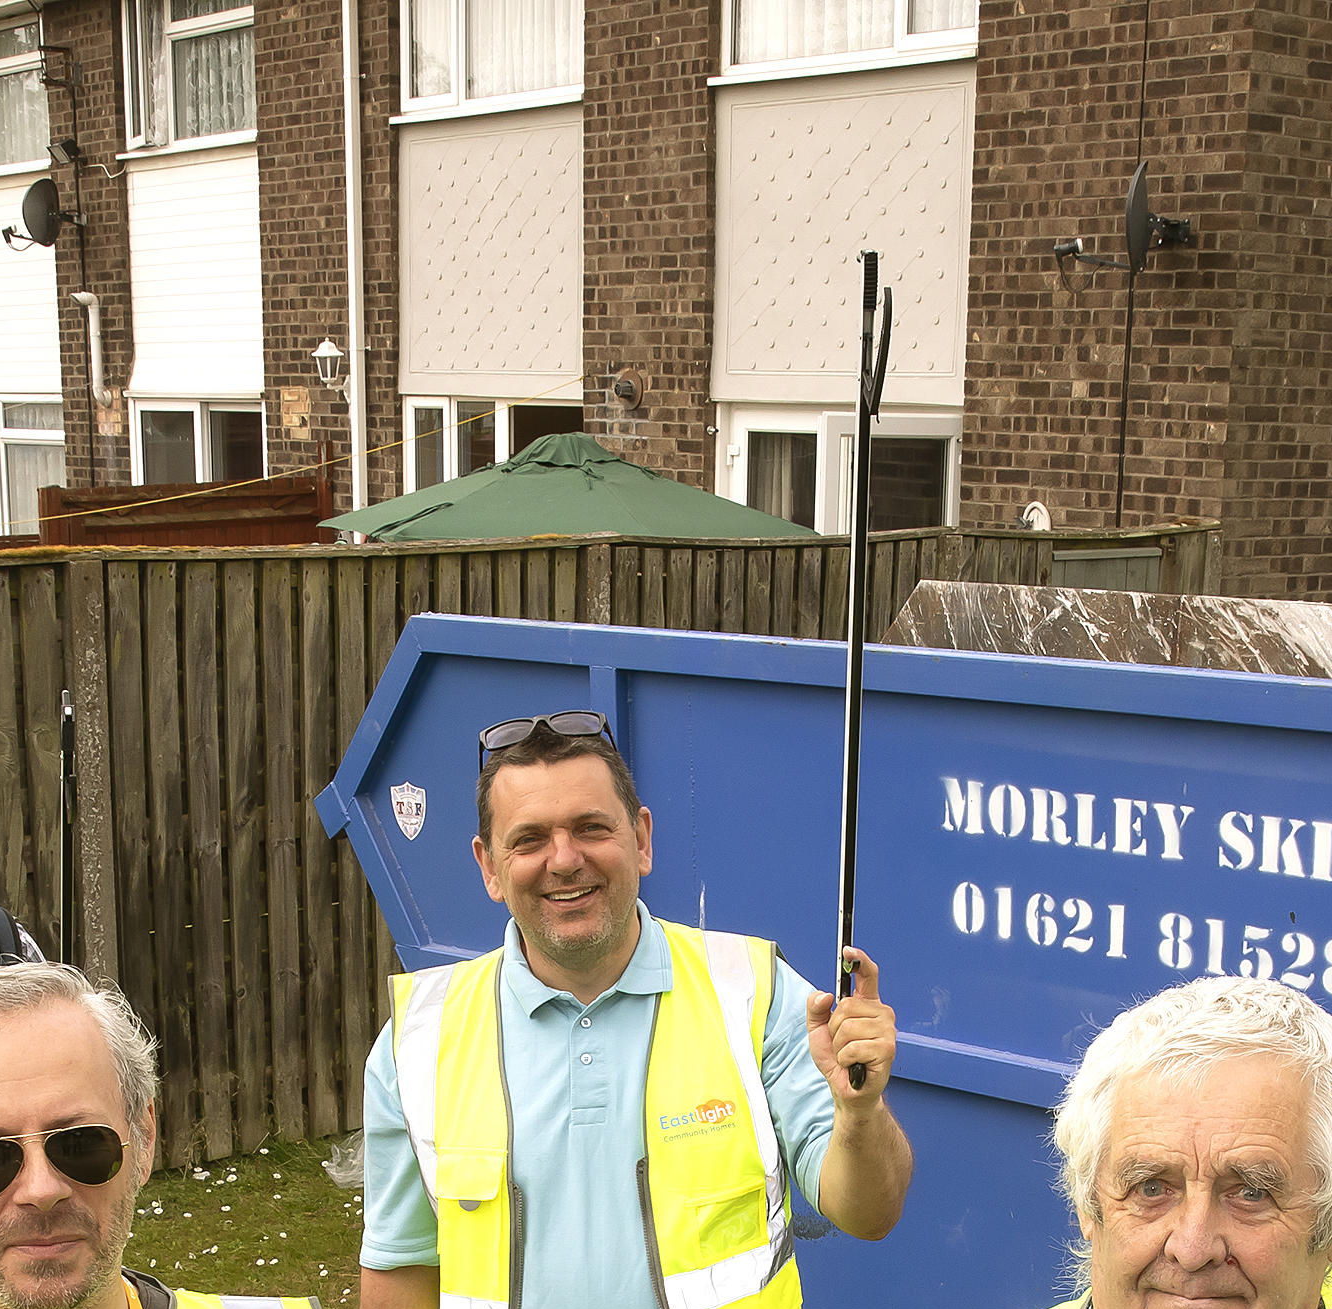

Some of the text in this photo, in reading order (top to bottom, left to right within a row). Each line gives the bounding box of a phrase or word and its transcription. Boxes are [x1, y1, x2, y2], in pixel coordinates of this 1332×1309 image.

[396, 801, 422, 816] TSR
[940, 776, 1194, 860] MORLEY
[952, 881, 1128, 960] 01621
[659, 1103, 734, 1130] Eastlight
[663, 1122, 736, 1143] Community Homes
